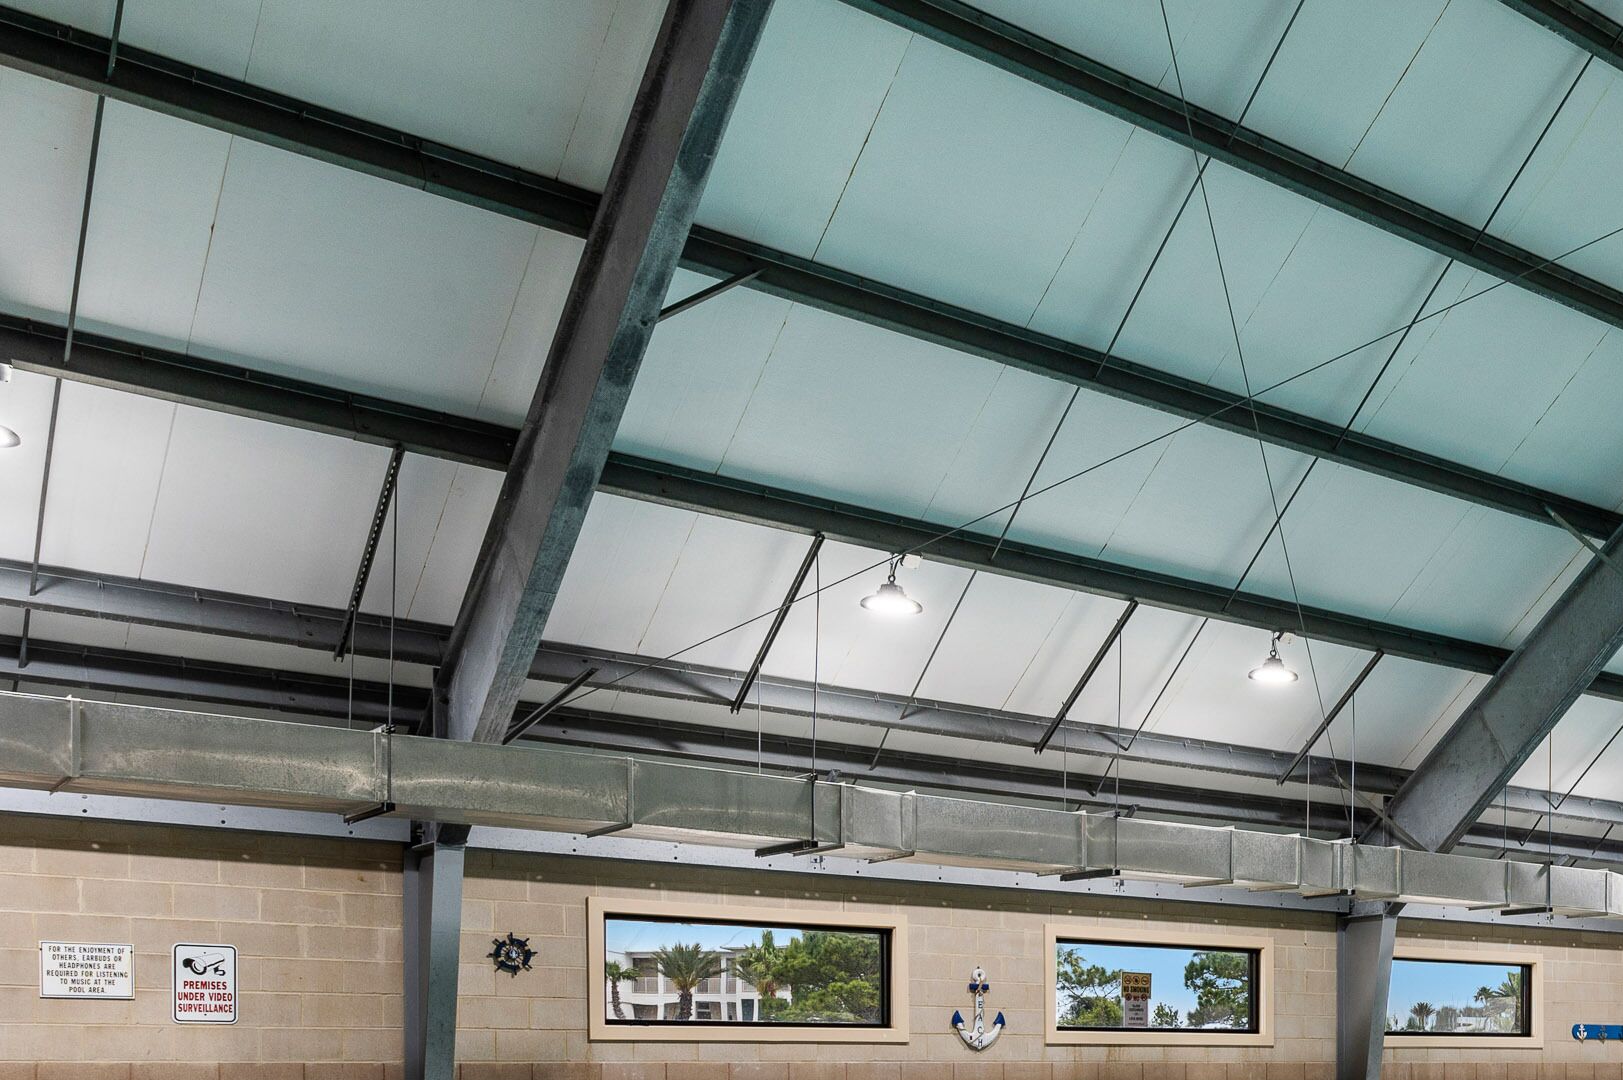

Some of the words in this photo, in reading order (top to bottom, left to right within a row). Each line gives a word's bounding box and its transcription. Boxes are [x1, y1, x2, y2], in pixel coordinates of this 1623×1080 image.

[48, 945, 61, 953] FOR
[59, 962, 101, 970] HEADPHONES
[183, 980, 227, 990] PREMISES
[177, 992, 205, 1001] UNDER
[208, 992, 233, 1002] VIDEO
[178, 1003, 233, 1013] SURVEILLANCE
